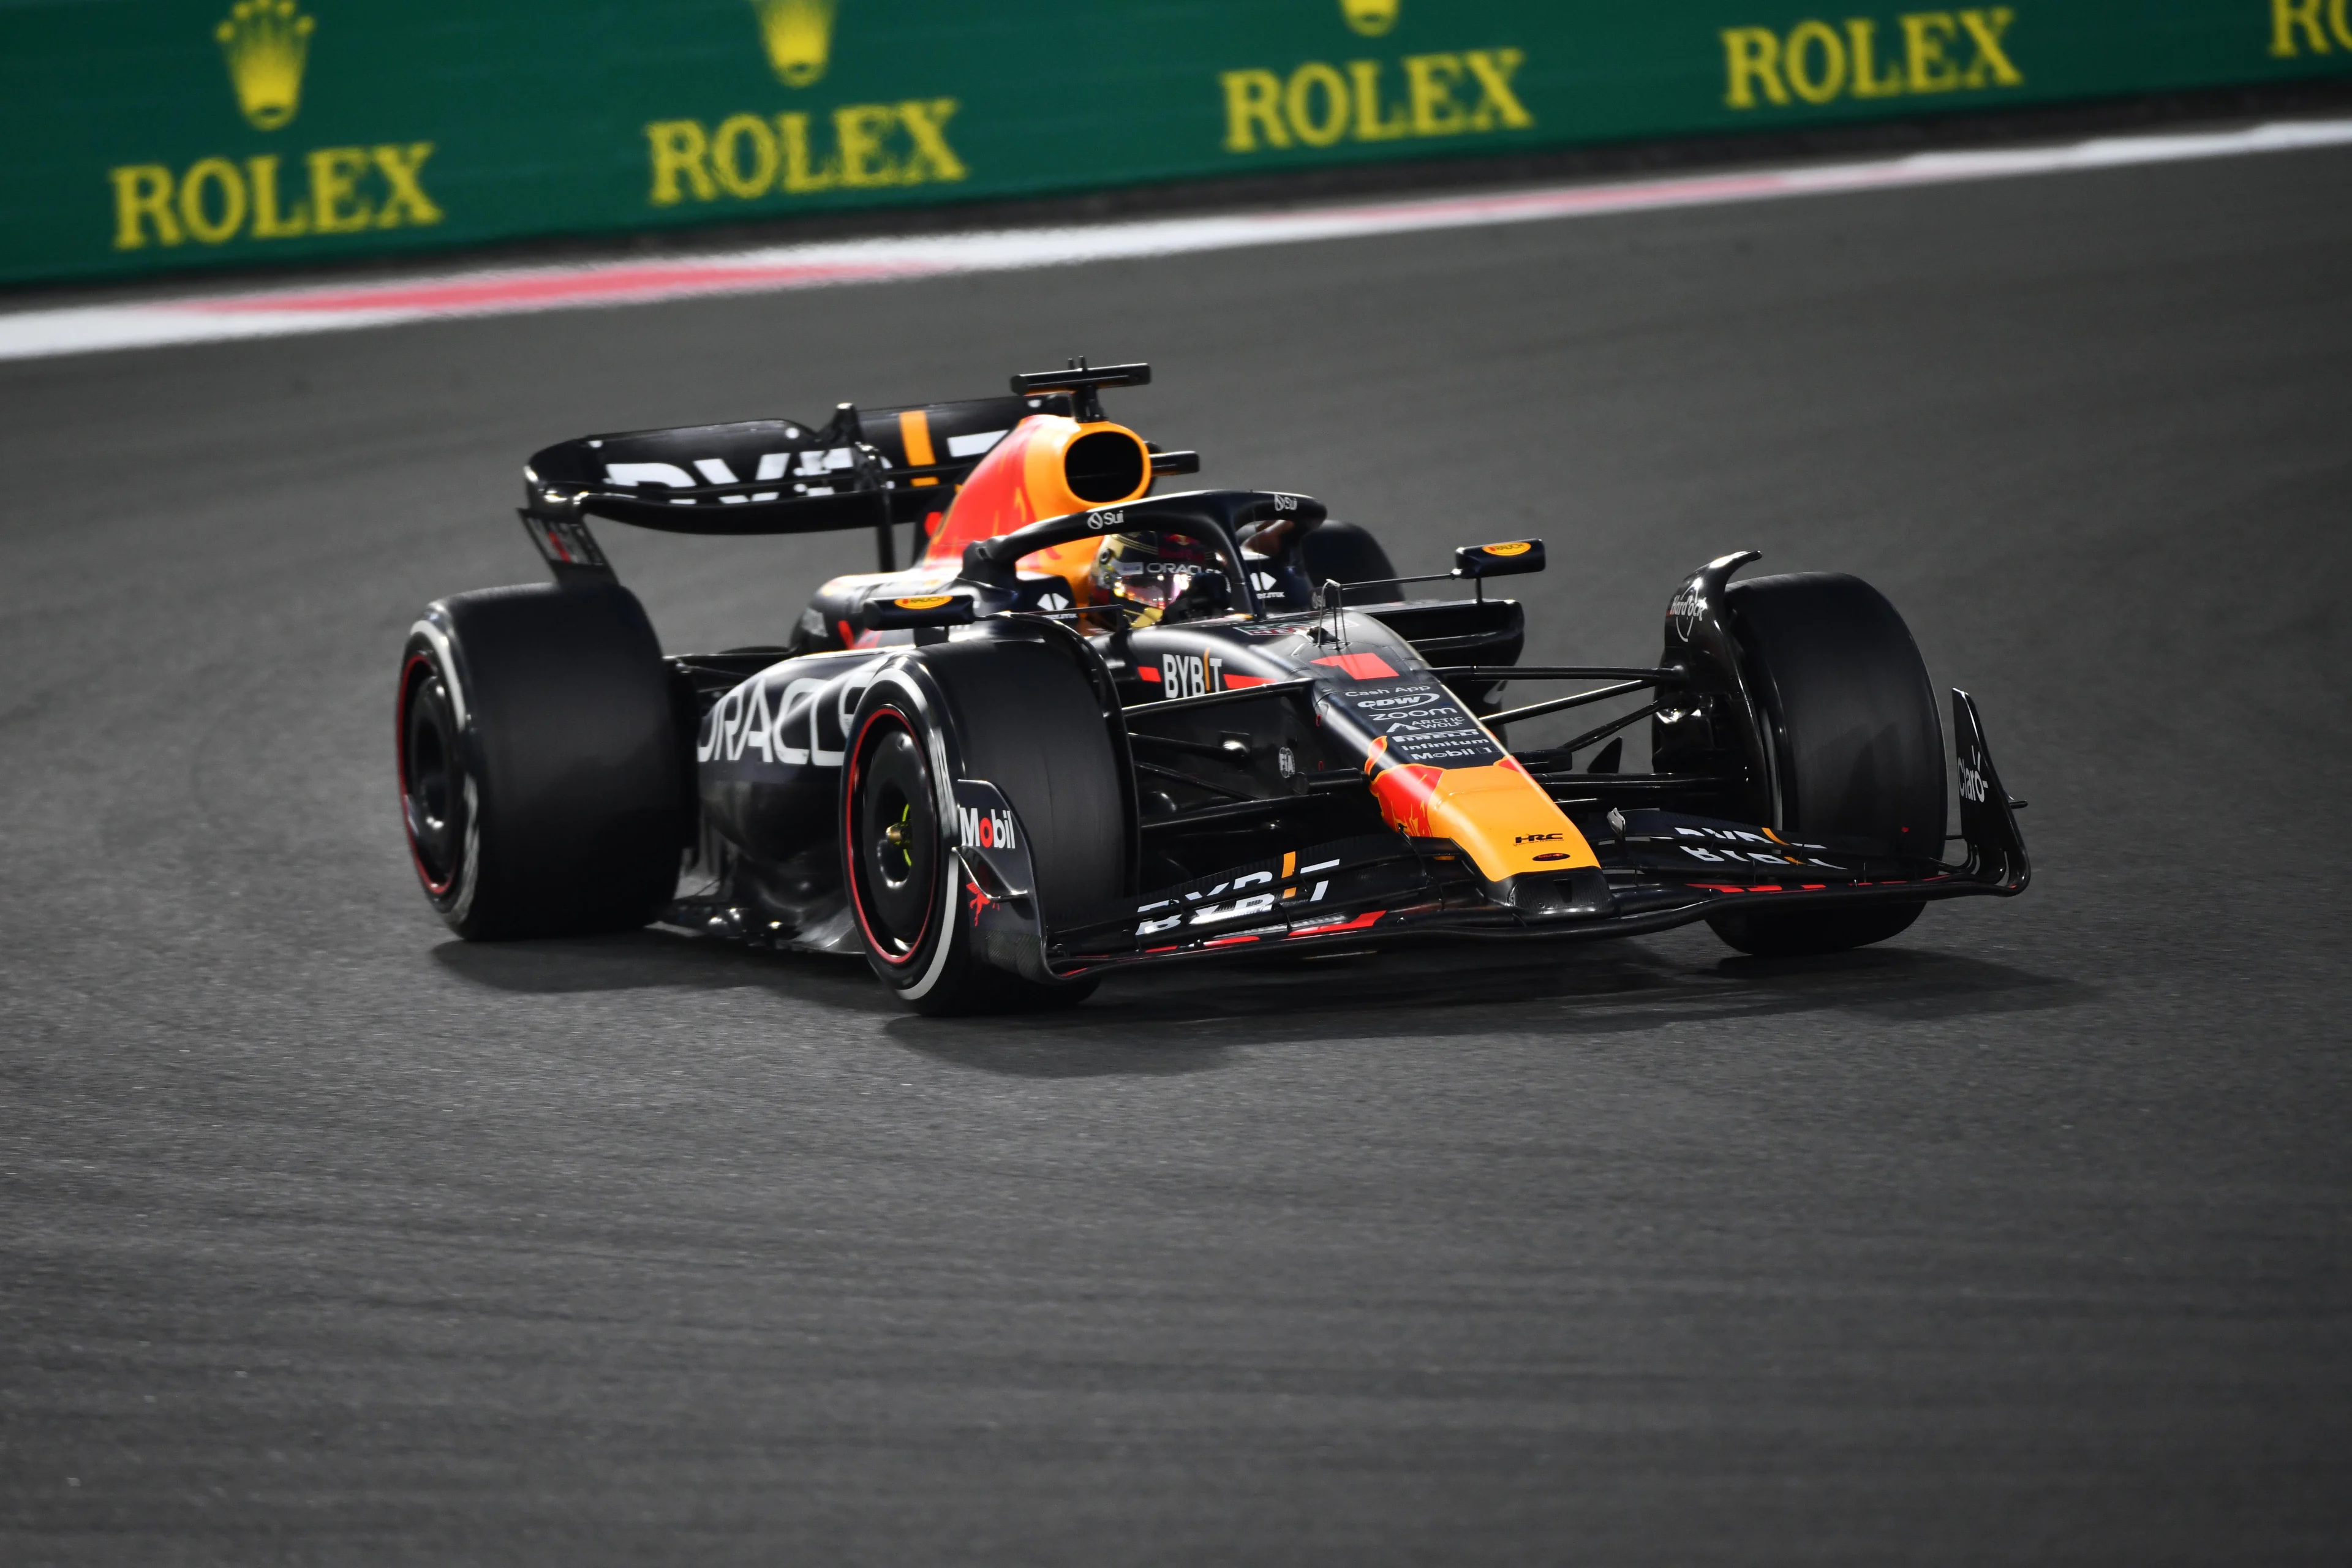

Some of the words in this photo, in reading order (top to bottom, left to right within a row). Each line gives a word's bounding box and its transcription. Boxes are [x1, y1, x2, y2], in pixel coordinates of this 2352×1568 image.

[1721, 7, 2022, 108] ROLEX
[1221, 49, 1531, 151] ROLEX
[646, 99, 966, 205] ROLEX
[111, 143, 441, 249] ROLEX
[1103, 510, 1124, 525] Sui
[1162, 647, 1223, 698] BYBIT
[1310, 652, 1400, 680] 1
[1344, 688, 1390, 697] Cash
[1357, 696, 1422, 707] CDW
[1368, 707, 1458, 721] zoom
[1411, 717, 1465, 726] ARCTIC
[1391, 728, 1480, 742] PIRELLI
[1401, 739, 1490, 750] infinitum
[1410, 748, 1476, 760] Mobil
[1958, 757, 1985, 803] Claro
[959, 807, 1016, 849] Mobil
[1515, 833, 1563, 843] HRC
